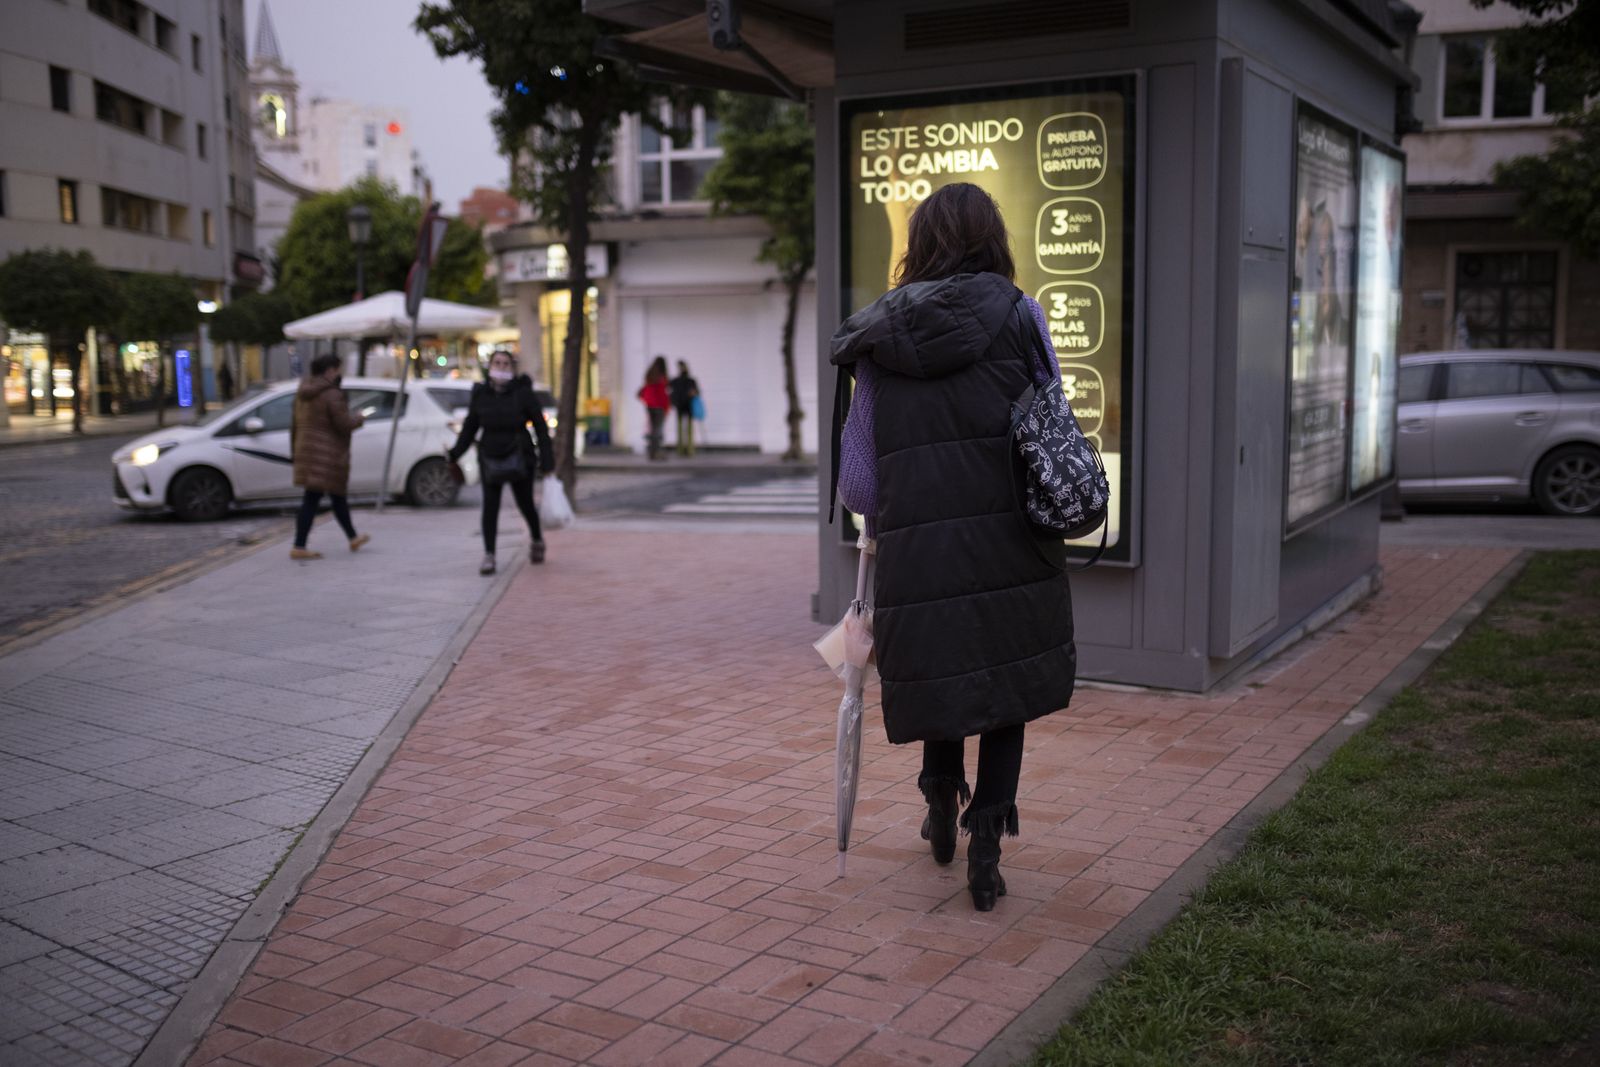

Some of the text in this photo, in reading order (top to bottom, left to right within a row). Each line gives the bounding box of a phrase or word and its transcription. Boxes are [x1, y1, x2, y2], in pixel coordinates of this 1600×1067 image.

[861, 117, 1024, 151] ESTE SONIDO
[1047, 129, 1096, 145] PRUEBA
[860, 147, 999, 177] LO CAMBIA
[1043, 157, 1101, 173] GRATUITA
[860, 178, 932, 204] TODO
[1050, 208, 1093, 236] 3 AÑOS
[1069, 223, 1081, 233] DE
[1039, 239, 1101, 256] GARANTÍA
[1049, 292, 1068, 320] 3
[1068, 307, 1079, 317] DE
[1049, 320, 1086, 333] PILAS
[1061, 374, 1077, 400] 3
[1076, 390, 1088, 399] DE
